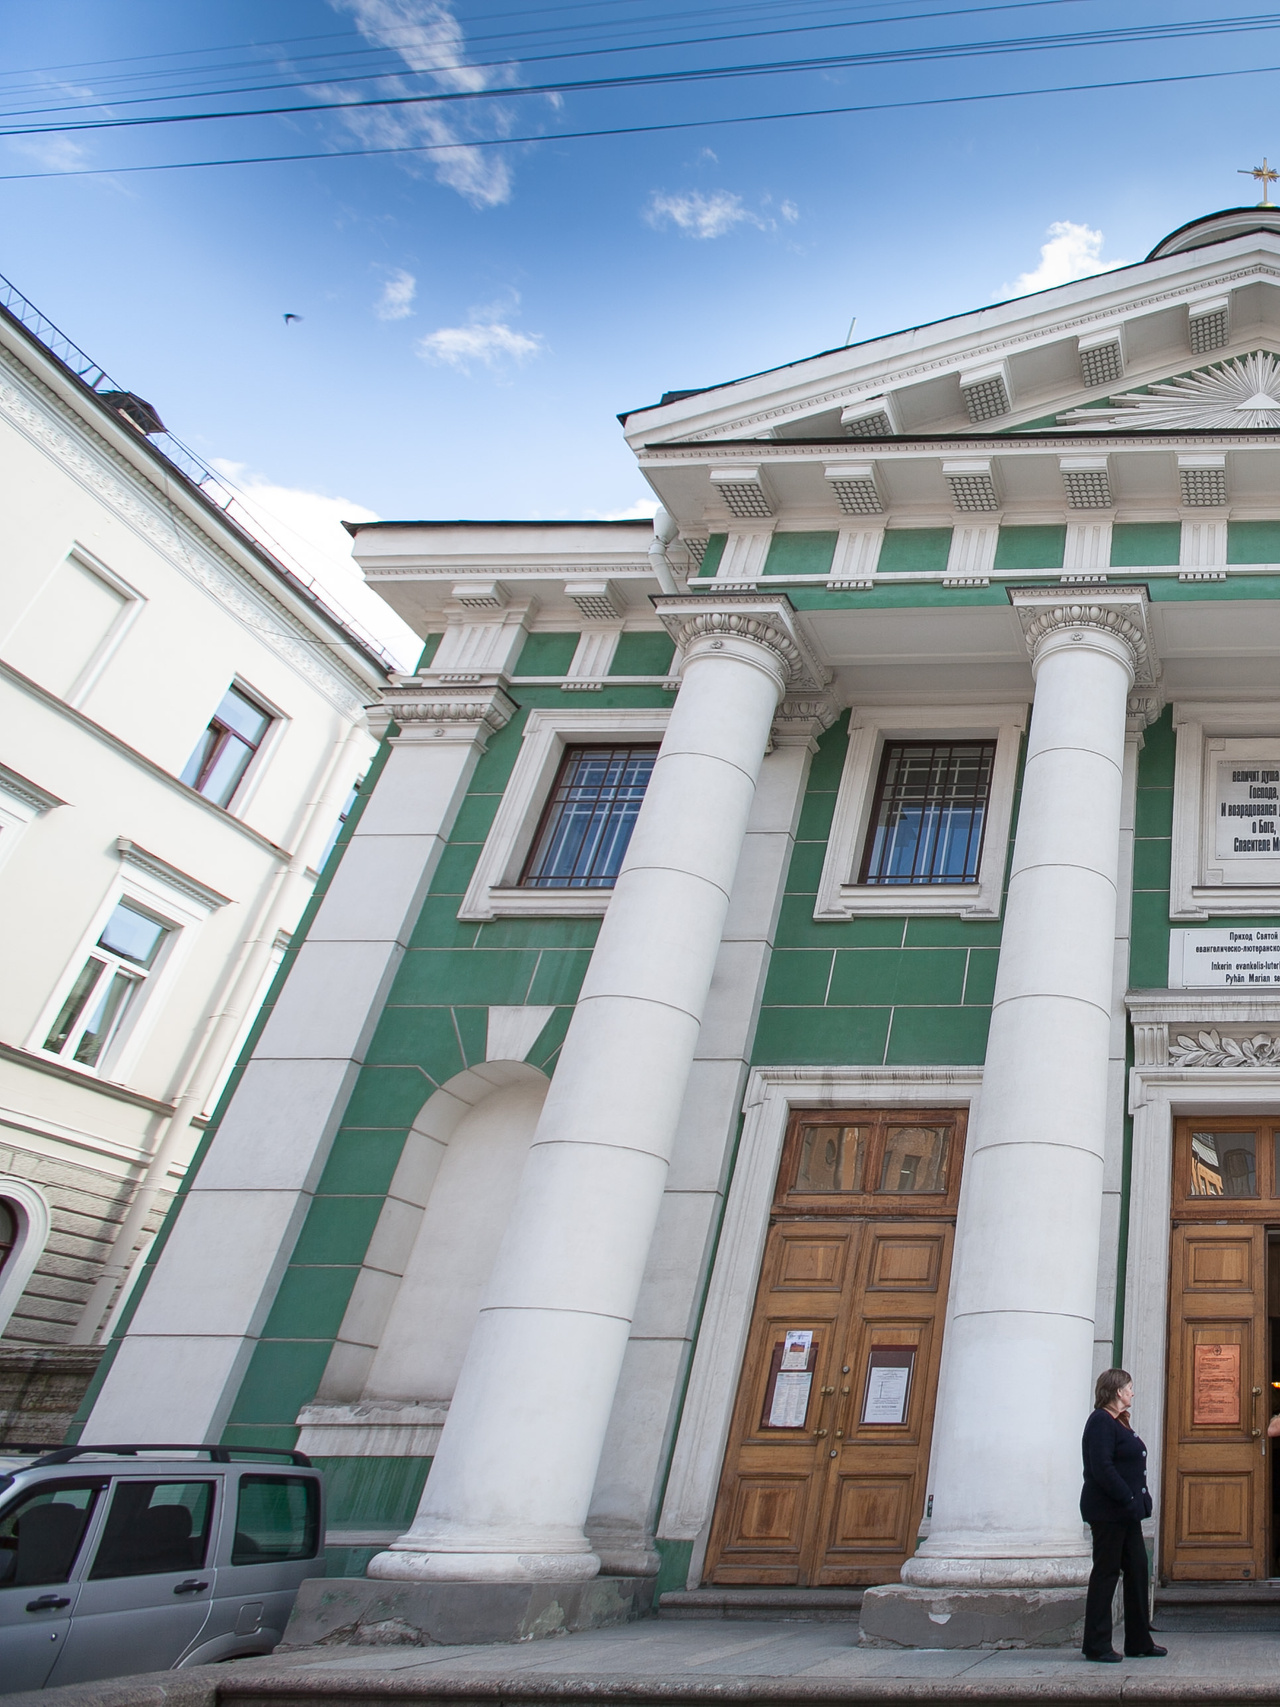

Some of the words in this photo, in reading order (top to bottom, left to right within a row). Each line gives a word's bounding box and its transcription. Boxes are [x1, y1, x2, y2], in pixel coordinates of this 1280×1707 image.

[1232, 770, 1260, 782] величит
[1261, 770, 1280, 784] душа
[1249, 785, 1279, 800] Господа,
[1221, 803, 1227, 817] И
[1228, 804, 1277, 819] возрадовался
[1252, 821, 1257, 834] о
[1258, 819, 1277, 835] Боге,
[1234, 837, 1271, 852] Спасителе
[1229, 931, 1253, 942] Приход
[1256, 931, 1279, 940] Святой
[1211, 961, 1232, 971] Inkerin
[1225, 973, 1245, 985] Pyhän
[1248, 973, 1271, 983] Marian
